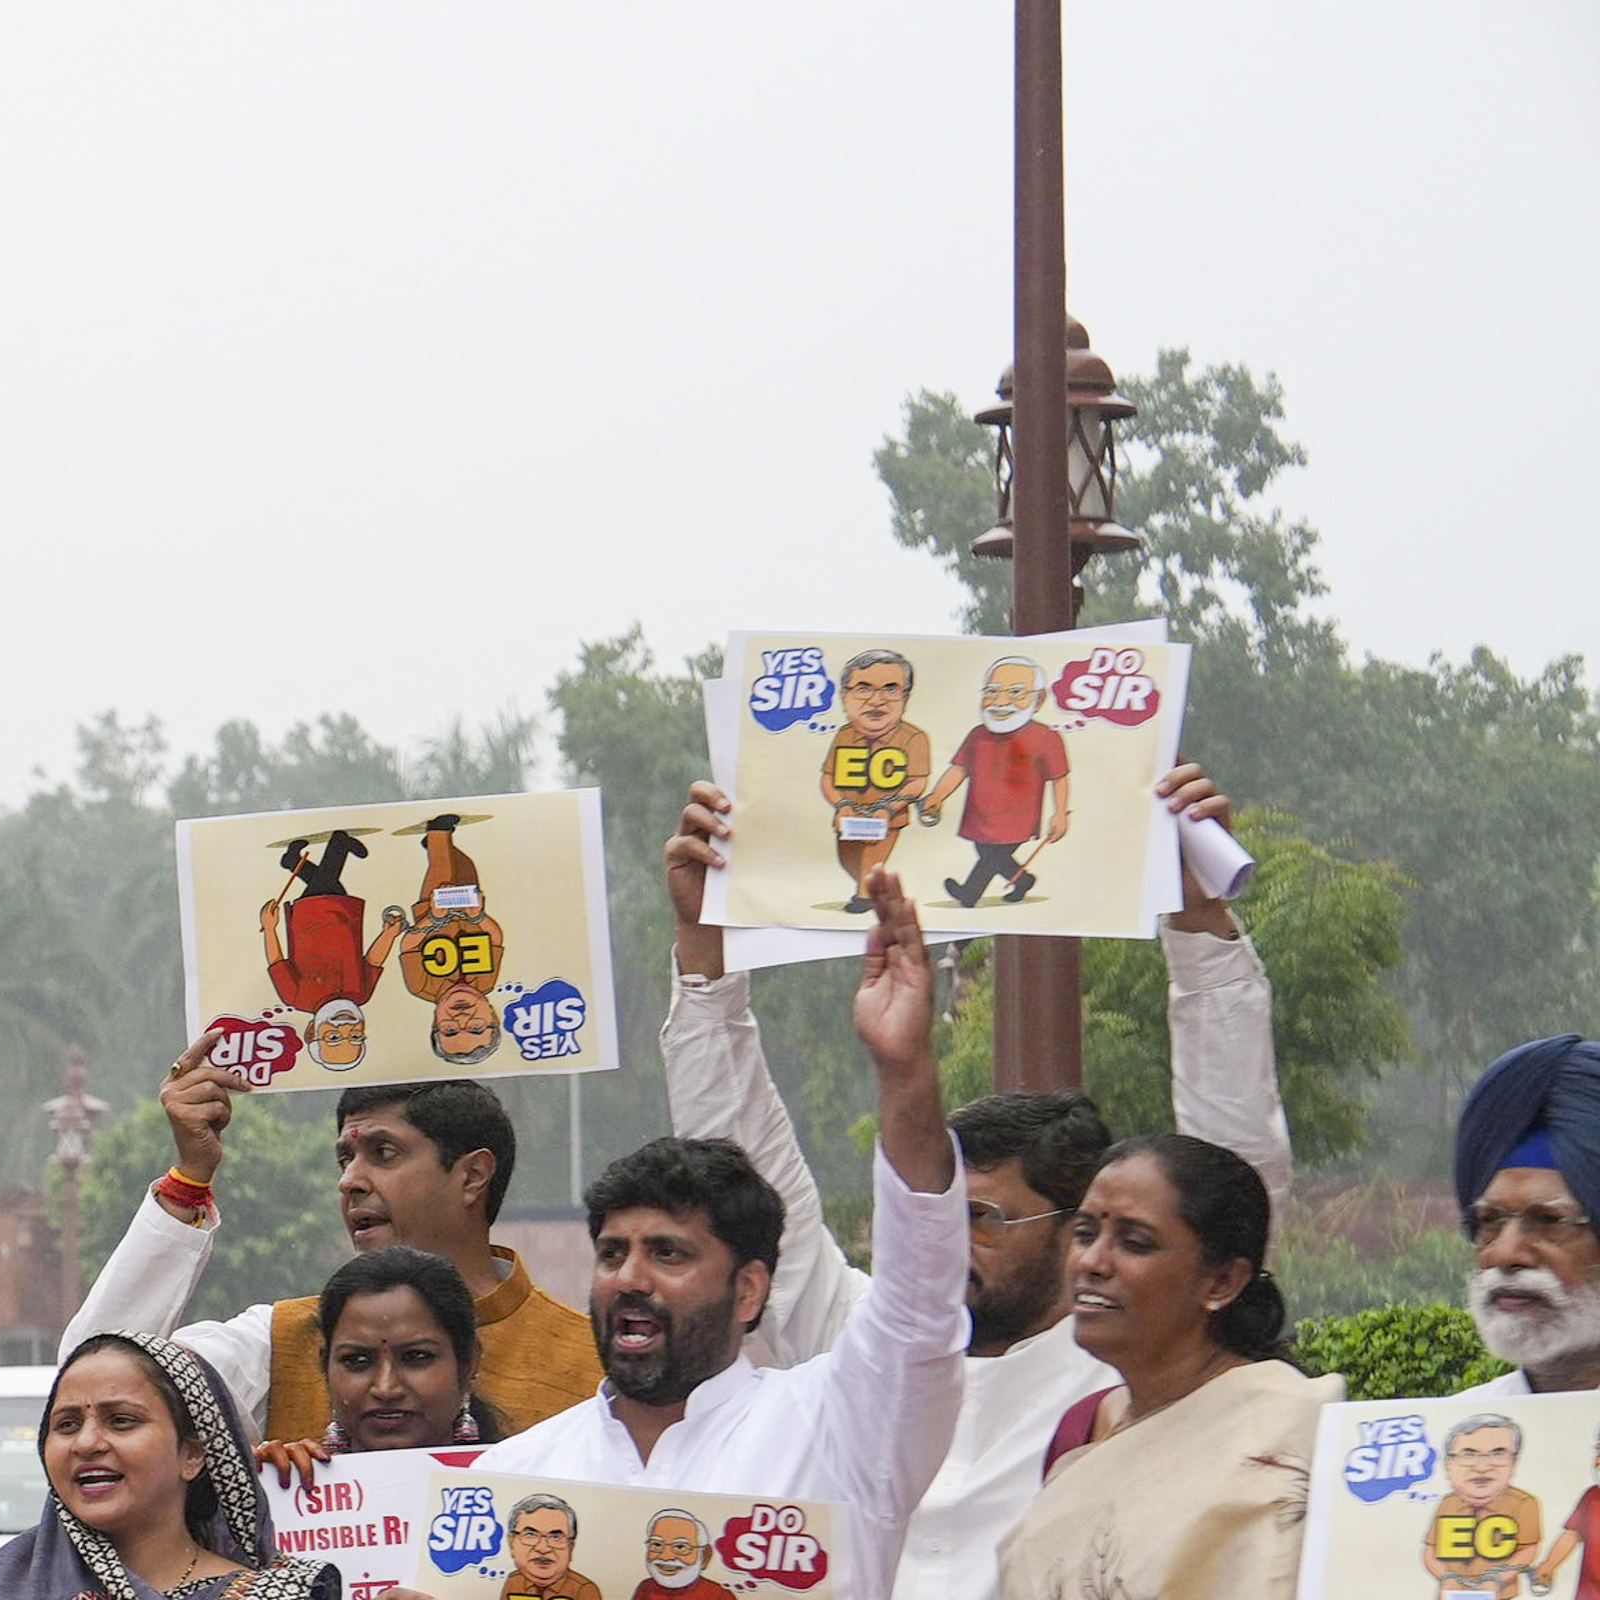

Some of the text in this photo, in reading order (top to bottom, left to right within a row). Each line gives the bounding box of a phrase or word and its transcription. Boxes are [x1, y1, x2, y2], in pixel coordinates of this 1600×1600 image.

[762, 648, 823, 677] YES
[1087, 648, 1144, 675] DO
[750, 674, 827, 711] SIR
[1066, 674, 1153, 711] SIR
[834, 747, 907, 790] EC
[423, 933, 494, 978] EC
[512, 998, 586, 1036] SIR
[211, 1028, 286, 1067] SIR
[523, 1031, 581, 1061] YES
[1358, 1416, 1424, 1446] YES
[1344, 1442, 1430, 1483] SIR
[294, 1479, 364, 1517] (SIR)
[441, 1487, 492, 1516] YES
[429, 1514, 497, 1553] SIR
[750, 1505, 803, 1533] DO
[1435, 1514, 1519, 1561] EC
[273, 1523, 378, 1555] NVISIBLE
[733, 1531, 818, 1574] SIR
